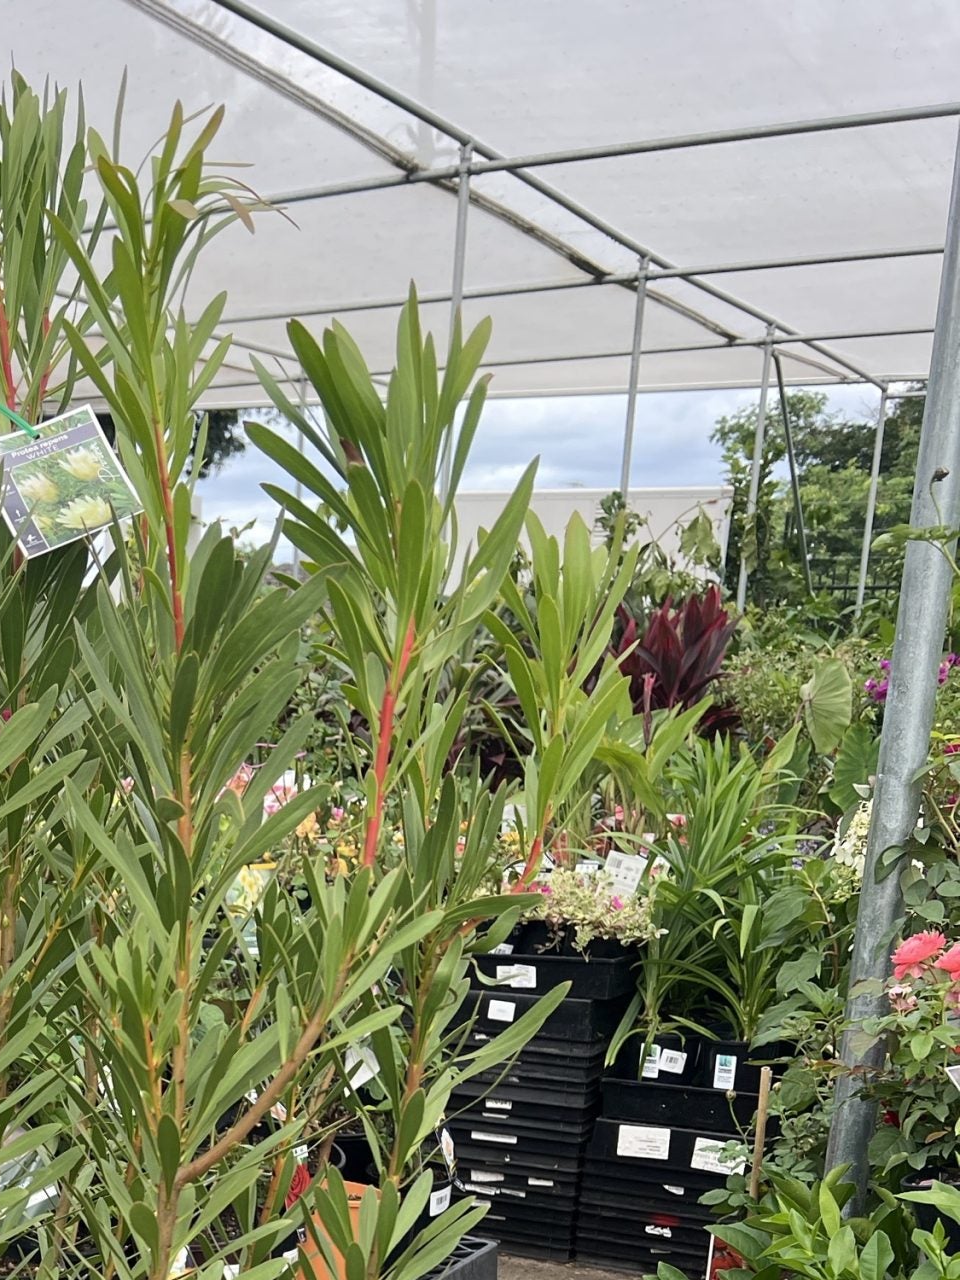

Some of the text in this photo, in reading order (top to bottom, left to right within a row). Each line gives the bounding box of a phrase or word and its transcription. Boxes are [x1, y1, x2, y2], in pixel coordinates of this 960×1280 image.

[11, 434, 69, 458] Protea repens
[26, 445, 59, 459] WHITE
